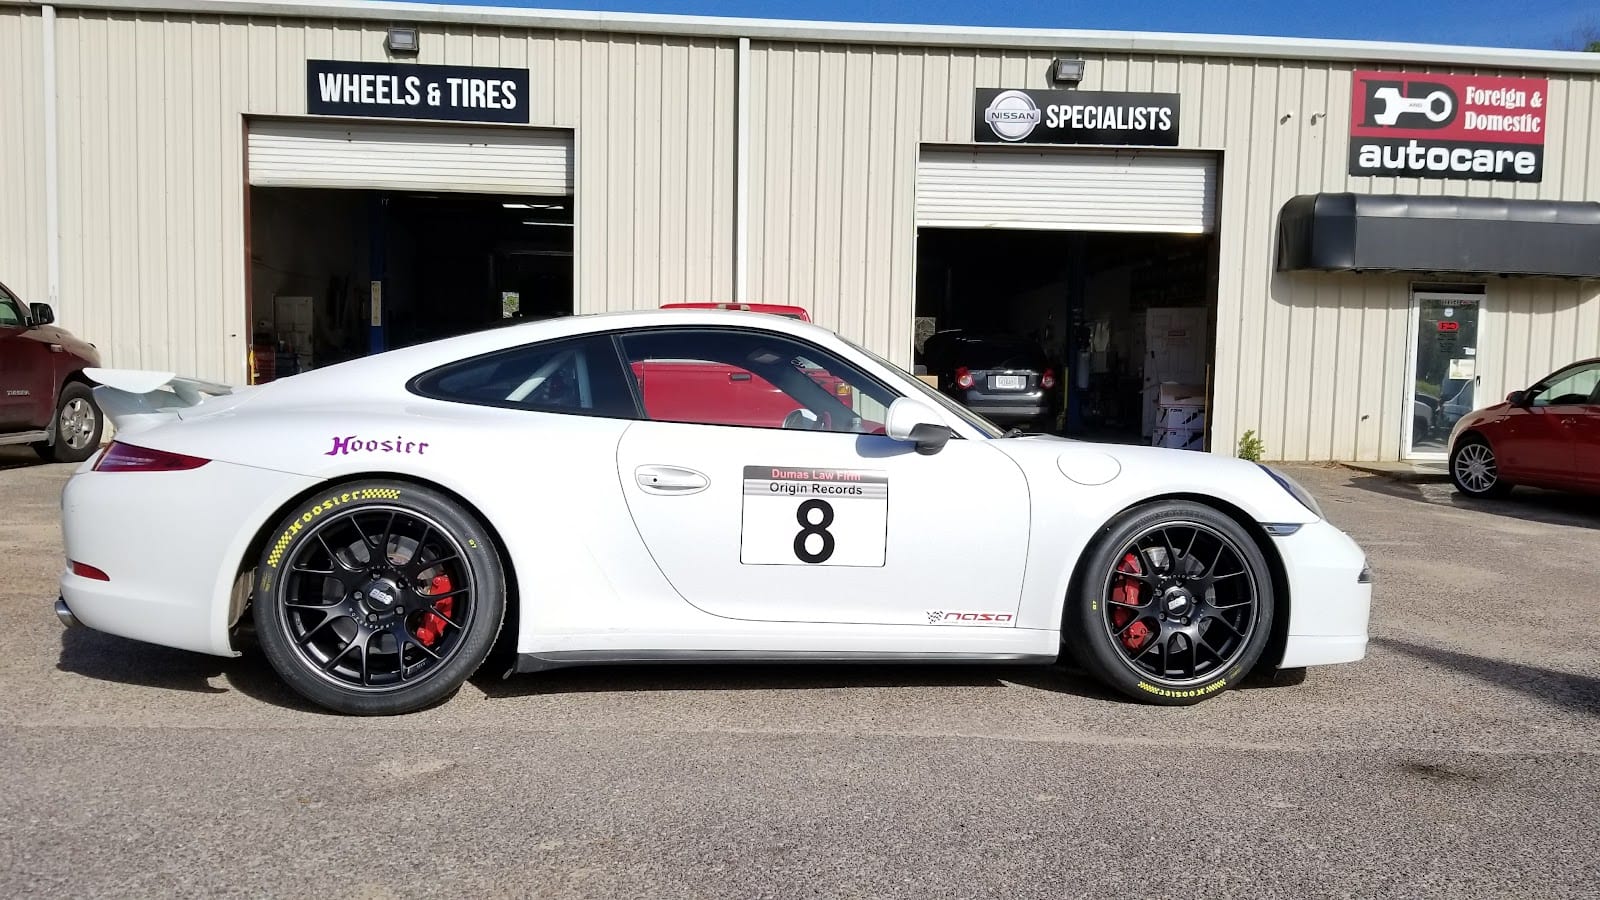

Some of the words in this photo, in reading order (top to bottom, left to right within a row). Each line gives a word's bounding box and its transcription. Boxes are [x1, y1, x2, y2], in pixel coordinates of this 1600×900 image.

[318, 72, 421, 106] WHEELS
[427, 82, 441, 107] &
[446, 77, 517, 110] TIRES
[1465, 86, 1526, 109] Foreign
[1530, 91, 1543, 108] &
[991, 111, 1035, 121] NISSAN
[1046, 104, 1172, 131] SPECIALISTS
[1464, 111, 1541, 133] Domestic
[1359, 139, 1536, 175] autocare
[323, 435, 429, 456] Hoosier
[771, 468, 809, 480] Dumas
[812, 469, 834, 480] Law
[837, 470, 861, 481] Firm
[769, 481, 808, 496] Origin
[812, 483, 863, 495] Records
[288, 490, 360, 536] Hoosier
[793, 498, 835, 564] 8
[944, 612, 1013, 622] nasa
